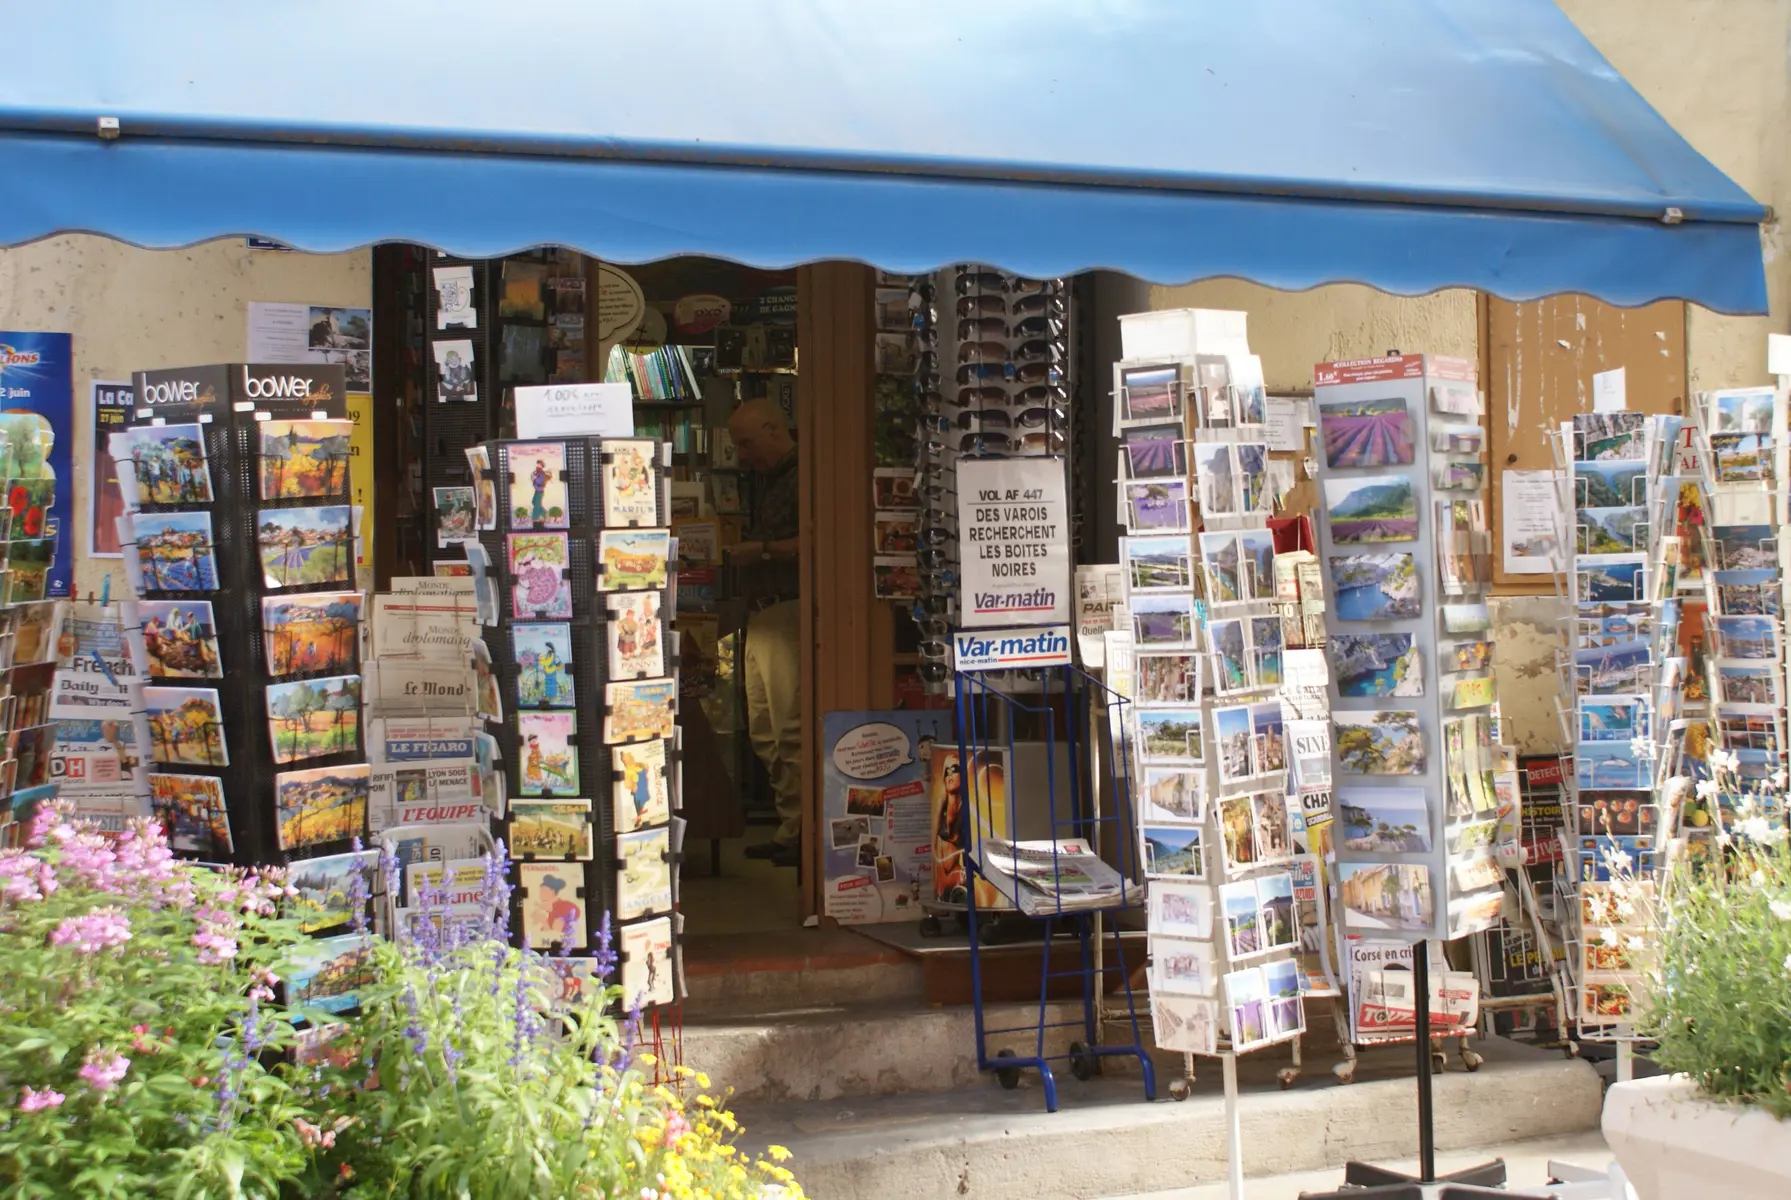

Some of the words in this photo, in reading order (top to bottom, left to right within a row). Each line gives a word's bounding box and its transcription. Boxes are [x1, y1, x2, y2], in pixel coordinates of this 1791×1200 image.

[766, 295, 797, 304] CHANC
[772, 304, 796, 313] GAGN
[244, 364, 313, 398] bower
[8, 387, 31, 399] juin
[98, 390, 115, 405] La
[118, 390, 134, 405] Ca
[978, 490, 1002, 501] VOL
[1005, 490, 1020, 500] AF
[1023, 488, 1044, 500] 447
[975, 507, 1000, 522] DES
[1003, 506, 1048, 521] VAROIS
[969, 524, 1056, 541] RECHERCHENT
[979, 545, 1001, 559] LES
[1005, 544, 1048, 558] BOITES
[991, 562, 1036, 577] NOIRES
[974, 587, 1056, 609] Var-matin
[957, 631, 1068, 657] Var-matin
[61, 679, 99, 695] Daily
[403, 681, 417, 695] Le
[391, 742, 410, 753] LE
[412, 741, 467, 753] FIGARO
[51, 758, 83, 775] DH
[427, 770, 447, 779] LYON
[448, 768, 468, 777] SOUS
[439, 778, 468, 787] MENACE
[418, 890, 485, 906] Triune
[1354, 949, 1381, 962] Corse
[1385, 949, 1398, 960] en
